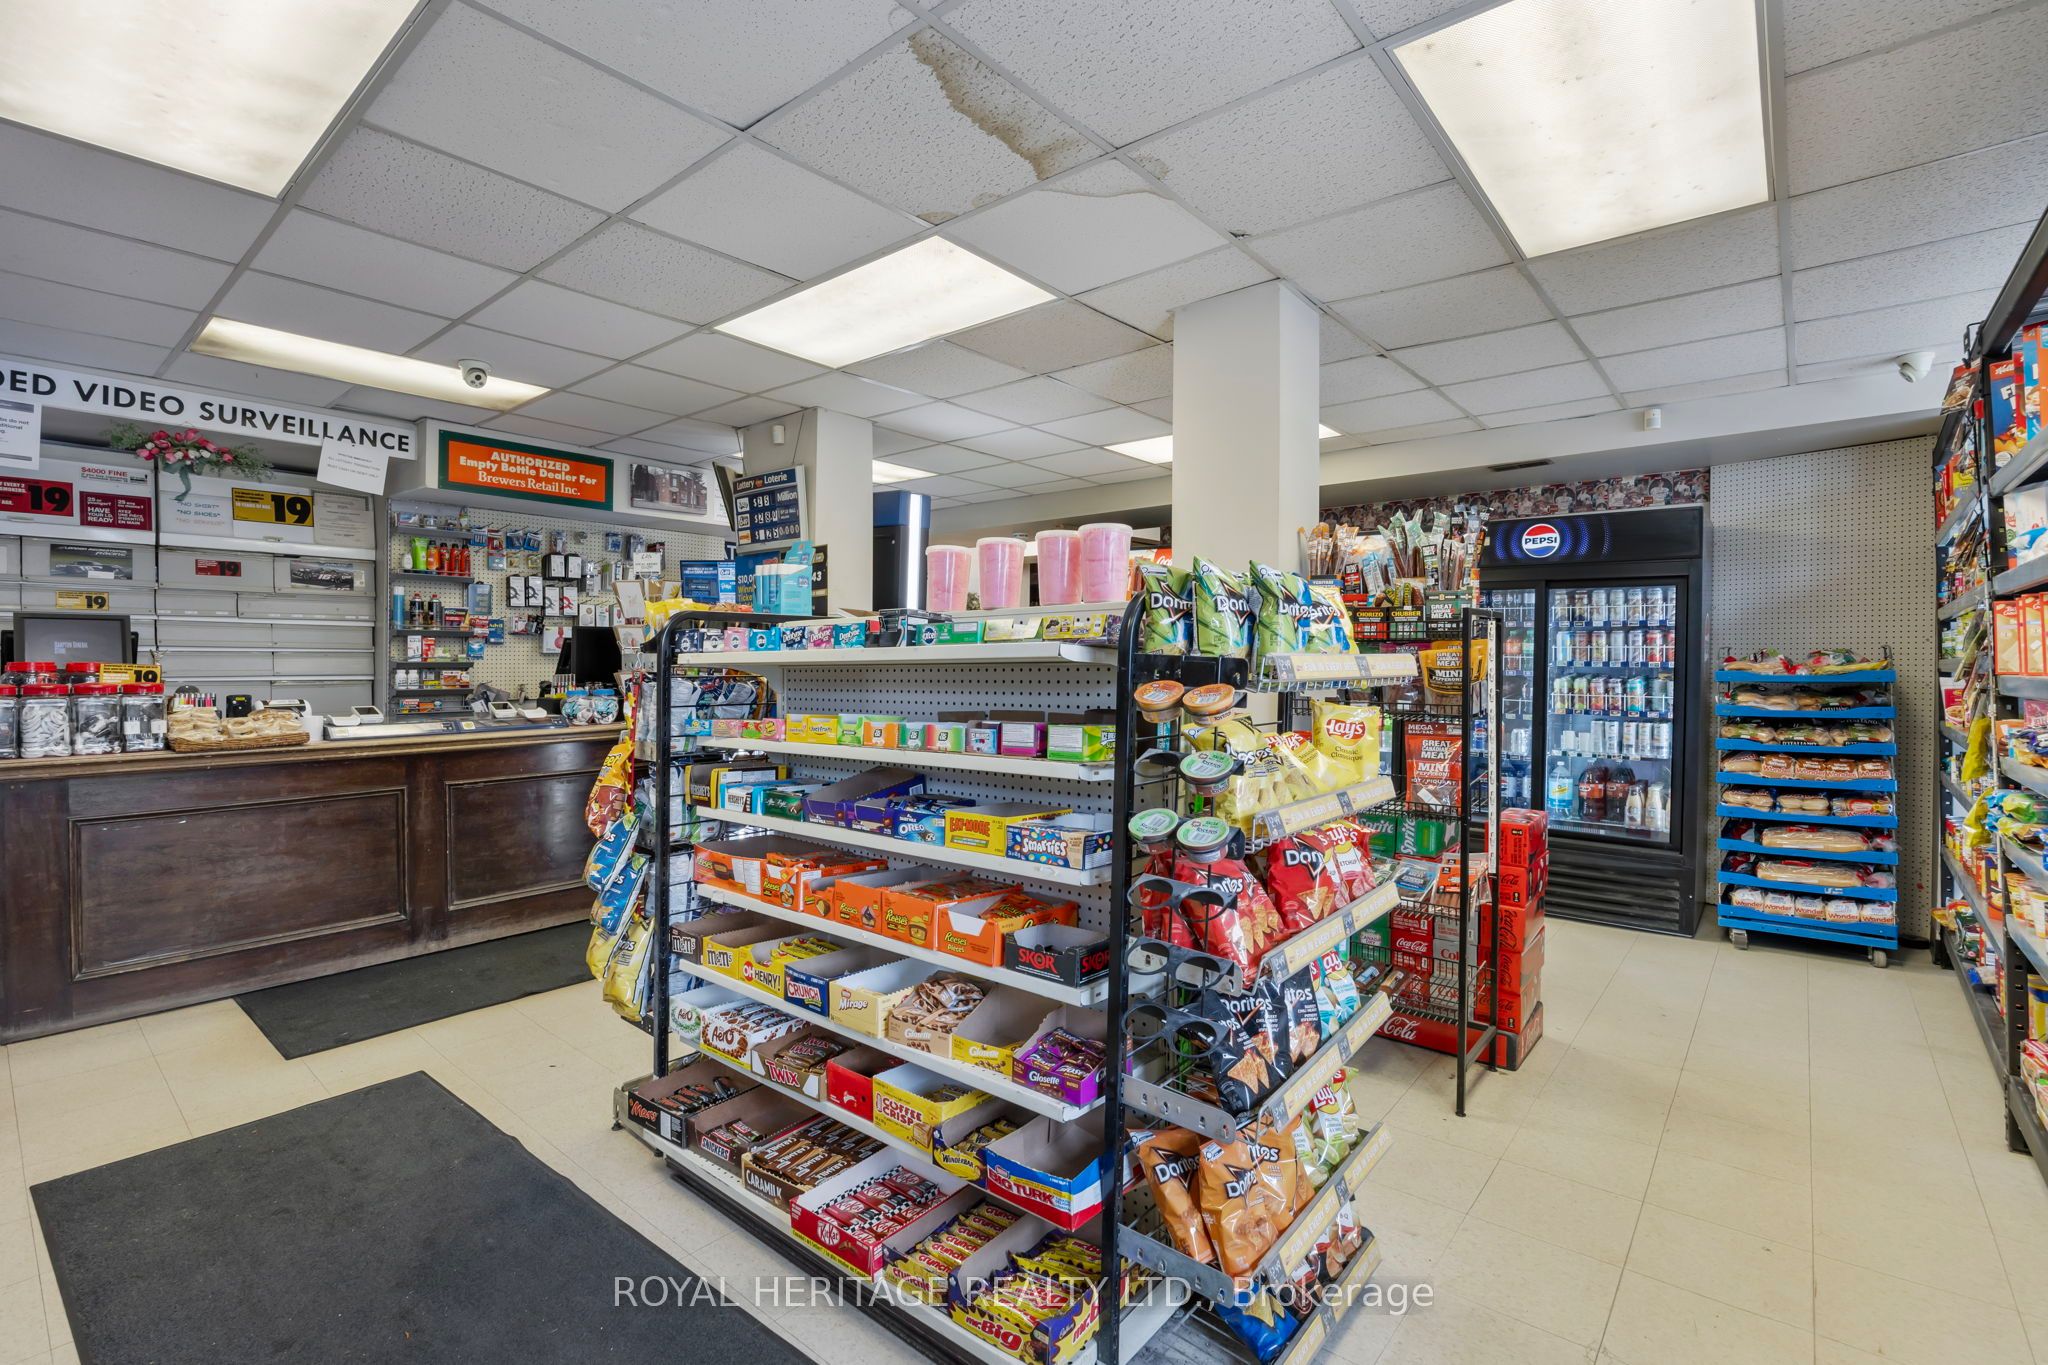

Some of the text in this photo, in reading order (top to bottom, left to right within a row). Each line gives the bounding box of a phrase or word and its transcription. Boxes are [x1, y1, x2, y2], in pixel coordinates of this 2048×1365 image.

[0, 370, 409, 452] ED VIDEO SURVEILLANCE
[491, 451, 571, 472] AUTHORIZED
[81, 467, 106, 475] $4000
[459, 456, 597, 486] Empty Bottle Dealer For
[478, 471, 581, 496] Brewers Retail Inc.
[736, 472, 788, 491] Lottery Loterie
[28, 485, 69, 512] 19
[777, 491, 798, 502] Million
[271, 494, 311, 524] 19
[88, 516, 113, 524] READY
[1524, 536, 1558, 545] PEPSI
[220, 561, 240, 577] 19
[85, 596, 107, 609] 19
[1391, 610, 1421, 618] CHUBBER
[782, 630, 803, 642] Dentyne
[810, 630, 831, 642] Dentyne
[1325, 718, 1366, 740] Lay's
[1422, 739, 1451, 747] GREAT
[1330, 752, 1363, 762] Classique
[1420, 751, 1450, 759] MEAT
[1417, 763, 1450, 772] MINI
[691, 785, 711, 798] HERSHEY'S
[727, 793, 745, 807] HERSHEY'S
[899, 823, 925, 835] OREO
[949, 817, 991, 837] EAT-MORE
[1358, 818, 1395, 835] Sprite
[1401, 813, 1416, 855] Sprite
[839, 903, 858, 916] Reese's
[885, 908, 909, 926] Reese's
[1828, 913, 1859, 921] Wonder
[1862, 915, 1894, 923] Wonder
[944, 931, 967, 946] Reese's
[1396, 937, 1428, 953] Coca-Cola
[947, 944, 966, 953] pieces
[1018, 948, 1058, 974] SKOR
[742, 964, 781, 992] OH HENRY!
[787, 980, 820, 1001] CRUNCH
[838, 999, 868, 1011] Mirage
[677, 1007, 694, 1021] Aero
[904, 1028, 932, 1040] Glosette
[1383, 1016, 1421, 1040] Cola
[712, 1027, 735, 1046] Aero
[968, 1046, 1000, 1059] Glosette
[1028, 1070, 1060, 1085] Glosette
[630, 1101, 657, 1121] Mars
[882, 1097, 922, 1122] COFFEE
[882, 1106, 914, 1127] CRISP
[701, 1138, 730, 1159] SNICKERS
[942, 1151, 975, 1168] WUNDERBAR
[745, 1170, 783, 1200] CARAMILK
[988, 1168, 1054, 1204] BIG TURK
[892, 1266, 930, 1292] crunchie
